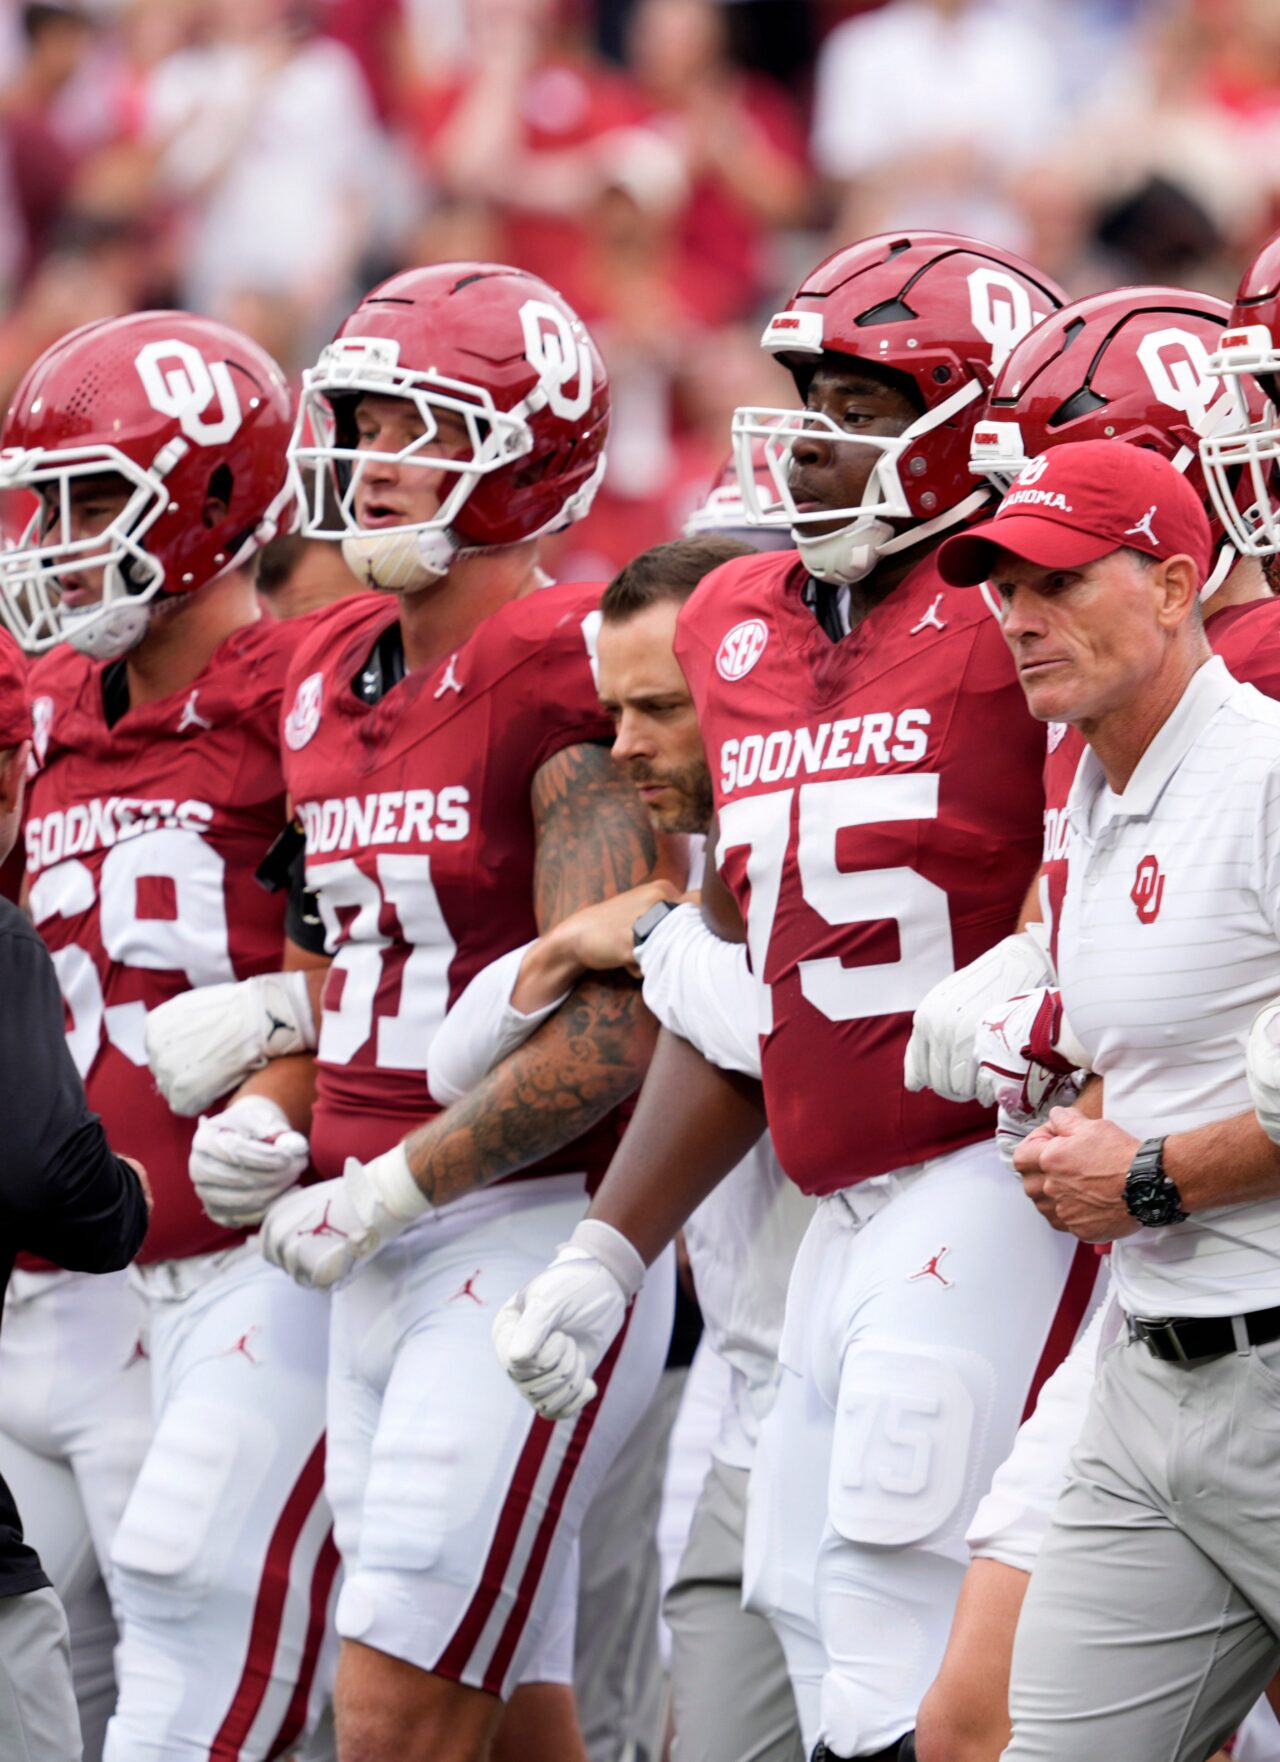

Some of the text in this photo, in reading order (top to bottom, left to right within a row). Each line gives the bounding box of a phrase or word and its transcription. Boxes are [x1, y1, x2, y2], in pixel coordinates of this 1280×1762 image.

[134, 339, 243, 447] OU
[518, 299, 593, 422] OU
[718, 621, 767, 678] SEC
[720, 709, 932, 795] SOONERS
[295, 785, 471, 856] OONERS
[714, 773, 956, 1036] 75
[1129, 854, 1166, 926] OU
[305, 854, 458, 1070] 81
[842, 1390, 942, 1497] 75
